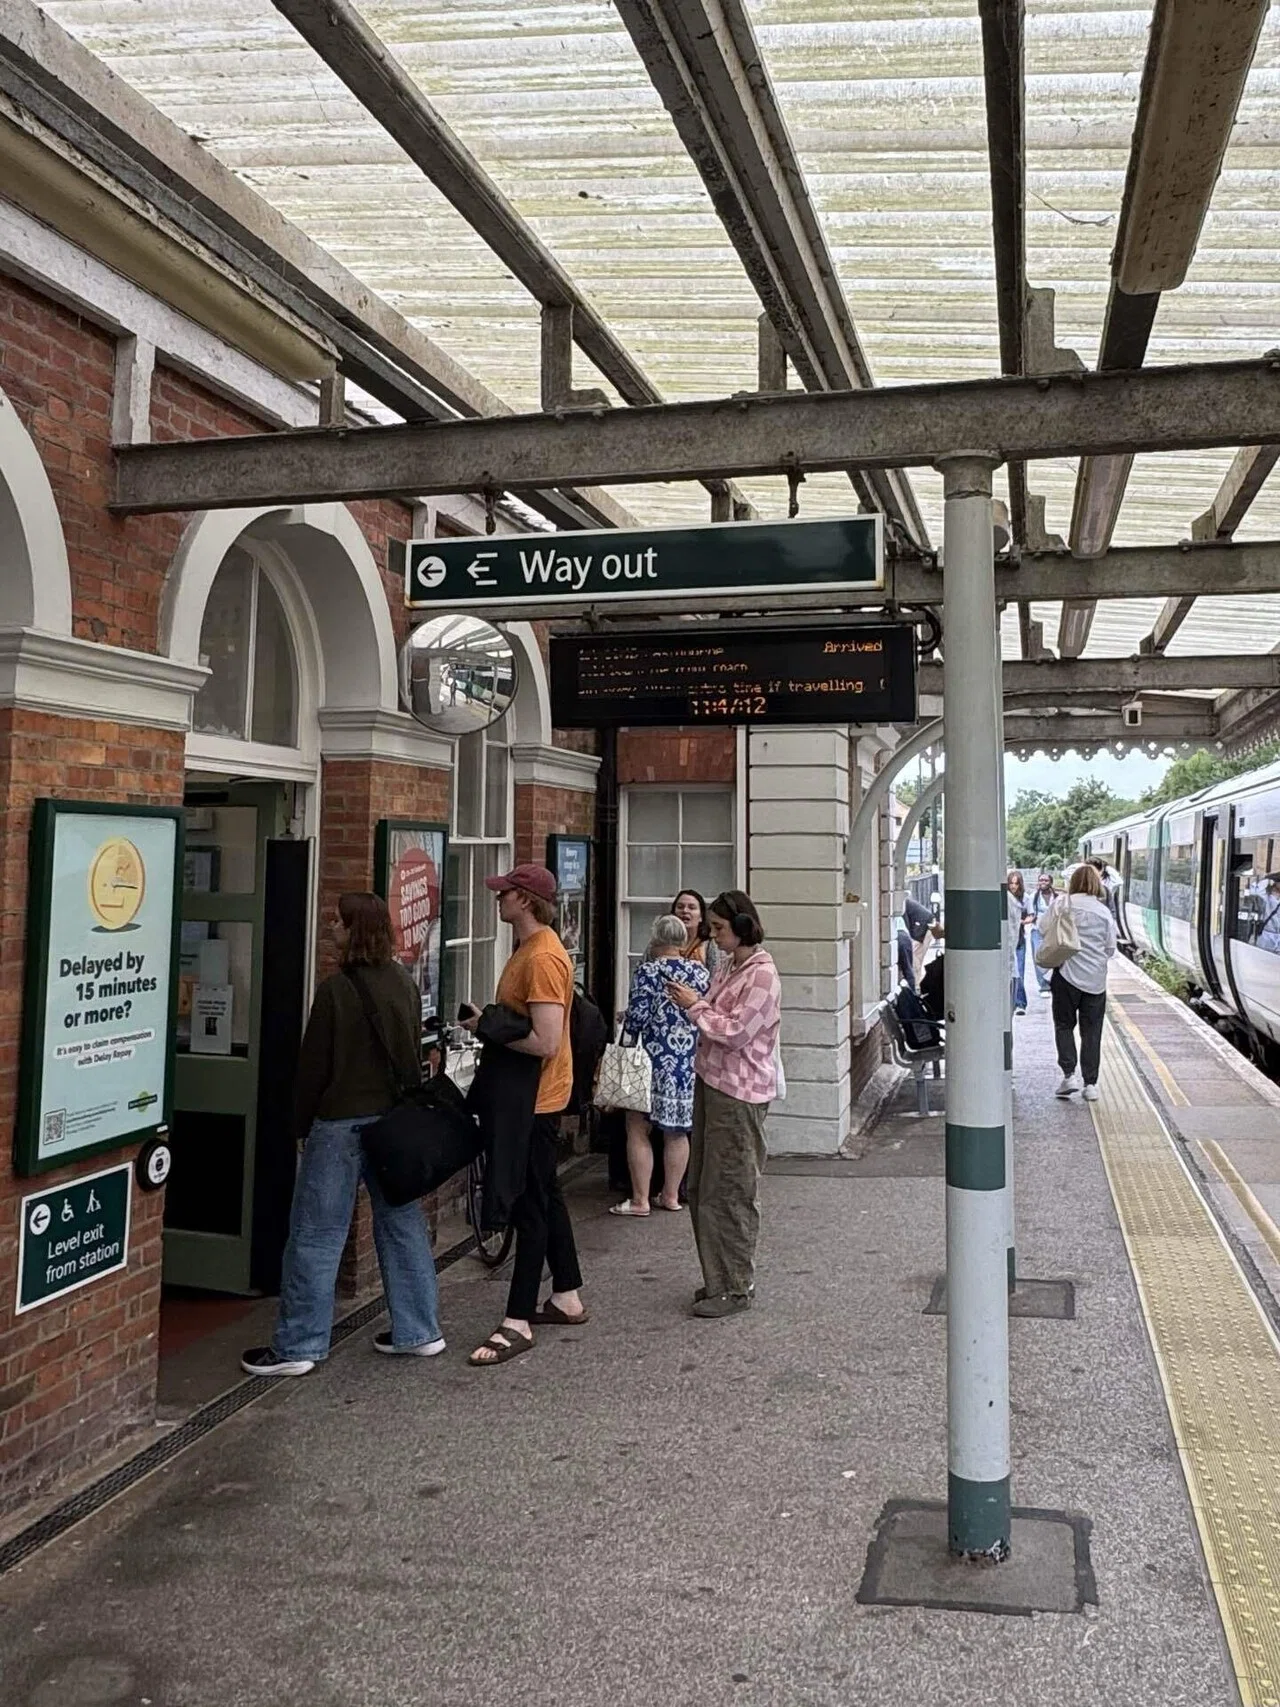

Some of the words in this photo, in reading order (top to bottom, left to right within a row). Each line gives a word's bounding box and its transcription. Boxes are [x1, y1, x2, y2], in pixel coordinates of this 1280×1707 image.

[519, 549, 593, 590] Way
[601, 547, 658, 580] out
[823, 640, 883, 653] Arrived
[788, 680, 864, 694] travelling
[60, 951, 123, 979] Delayed
[126, 951, 145, 974] by
[76, 982, 95, 1001] 15
[98, 976, 157, 998] minutes
[64, 1012, 82, 1028] or
[84, 1000, 132, 1025] more?
[48, 1231, 80, 1259] Level
[83, 1223, 104, 1245] exit
[46, 1260, 77, 1284] from
[79, 1242, 120, 1270] station
